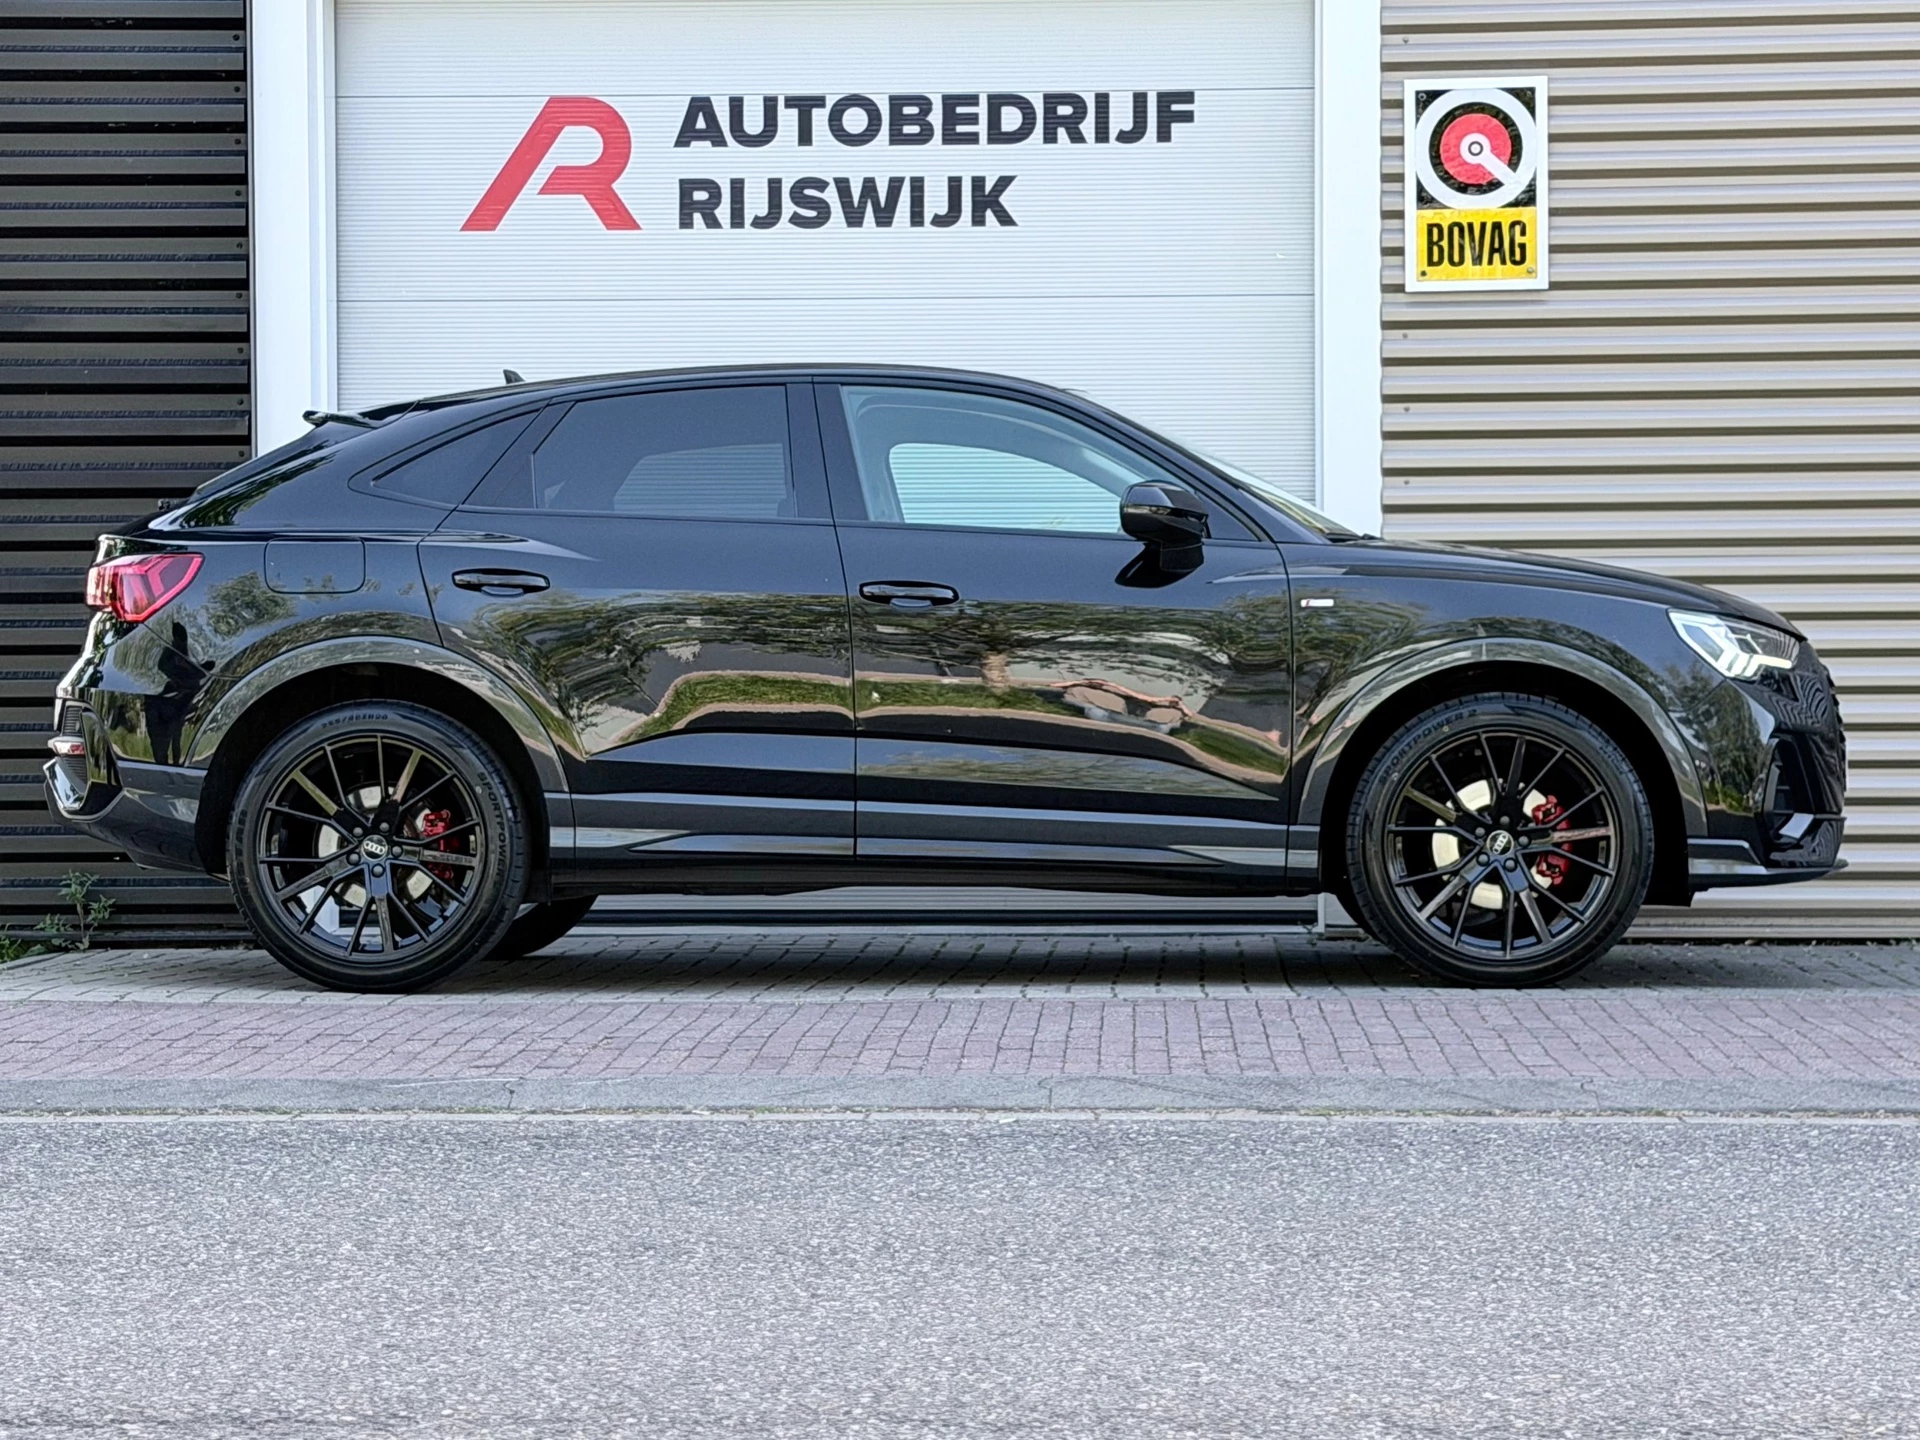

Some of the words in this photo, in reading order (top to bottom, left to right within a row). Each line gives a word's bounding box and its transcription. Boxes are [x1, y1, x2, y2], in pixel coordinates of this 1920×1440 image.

[673, 91, 1195, 148] AUTOBEDRIJF
[678, 175, 1018, 230] RIJSWIJK
[1426, 220, 1527, 267] BOVAG
[1380, 711, 1464, 784] SPORTPOWER
[477, 771, 507, 877] SPORTPOWER
